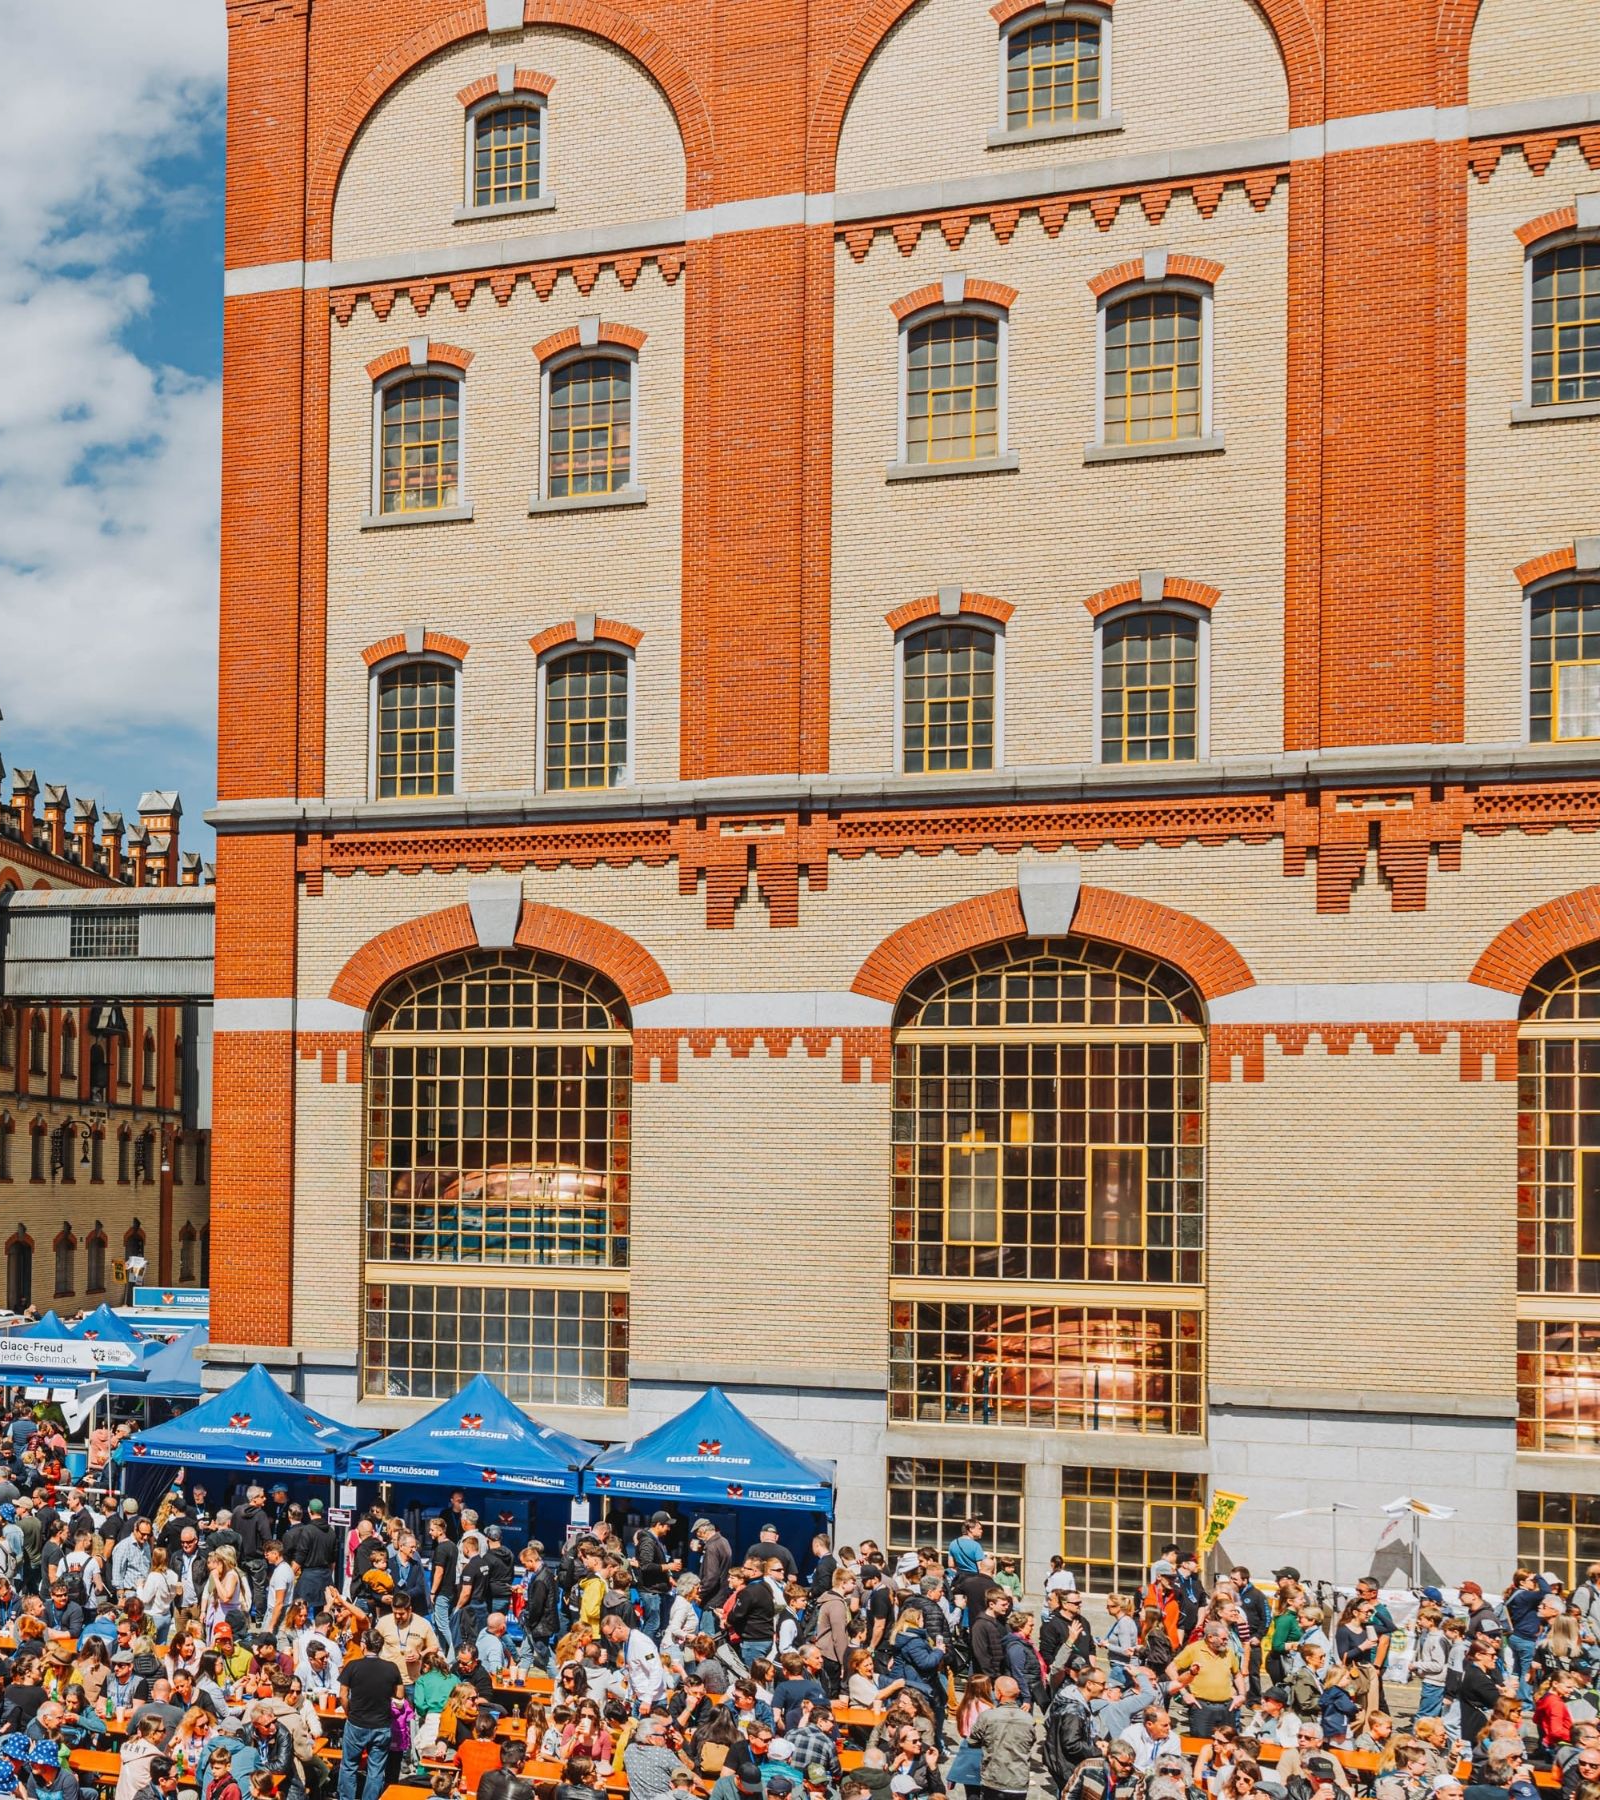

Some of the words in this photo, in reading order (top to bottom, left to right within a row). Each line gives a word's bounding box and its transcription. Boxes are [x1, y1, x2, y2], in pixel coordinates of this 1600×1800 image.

[0, 1341, 63, 1353] Glace-Freud
[1, 1351, 22, 1363] jede
[25, 1352, 78, 1364] Gschmack
[199, 1427, 273, 1438] FELDSCHLÖSSCHEN
[430, 1430, 509, 1440] FELDSCHLÖSSCHEN
[150, 1449, 207, 1461] FELDSCHLÖSSCHEN
[666, 1455, 751, 1465] FELDSCHLÖSSCHEN
[263, 1457, 322, 1468] FELDSCHLÖSSCHEN
[378, 1465, 439, 1476] FELDSCHLÖSSCHEN
[615, 1480, 681, 1493] FELDSCHLÖSSCHEN
[748, 1490, 816, 1503] FELDSCHLÖSSCHEN
